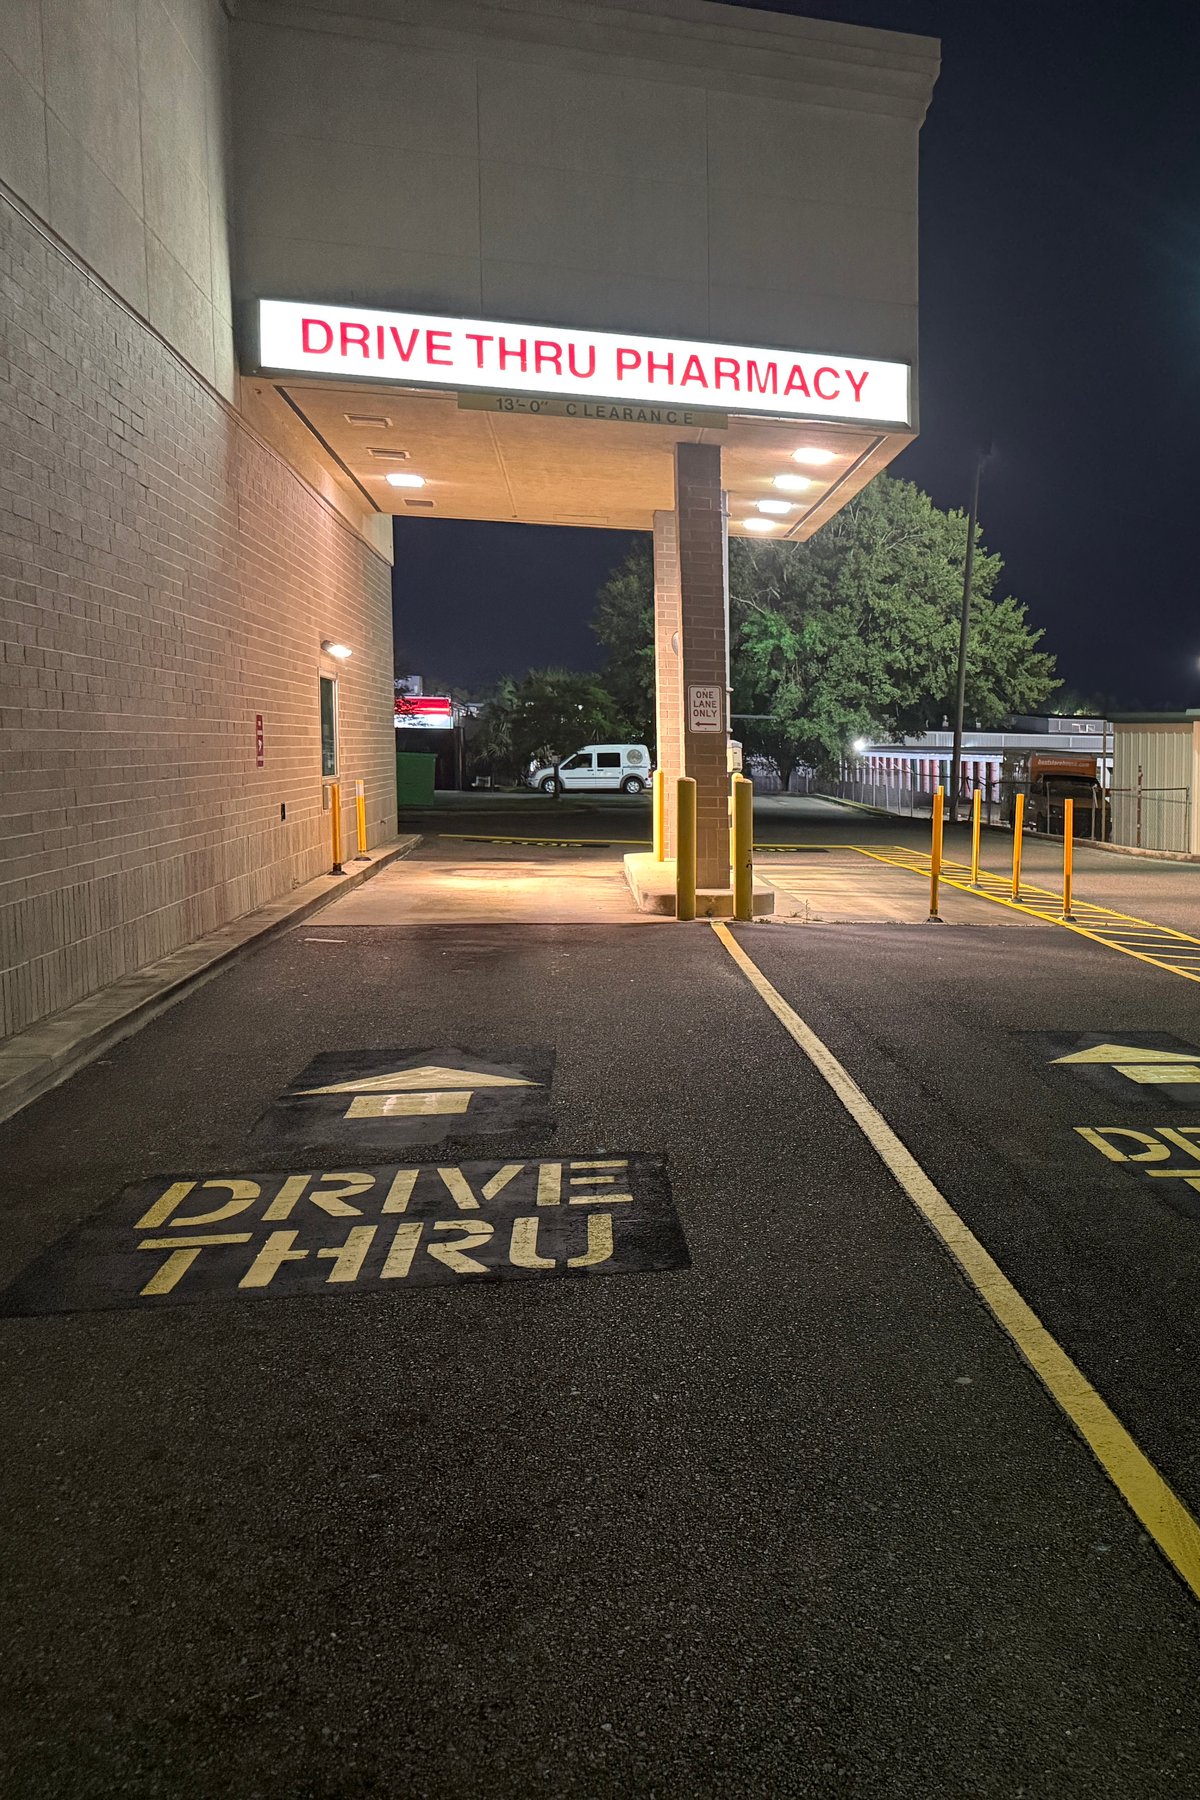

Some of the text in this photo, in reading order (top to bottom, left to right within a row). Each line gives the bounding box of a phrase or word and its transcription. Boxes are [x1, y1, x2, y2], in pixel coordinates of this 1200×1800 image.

[301, 318, 870, 403] DRIVE THRU PHARMACY
[496, 398, 694, 425] 13'-0" CLEARANCE
[693, 700, 717, 709] LANE
[695, 690, 714, 699] ONE
[693, 709, 717, 718] ONLY
[132, 1159, 635, 1230] DRIVE
[136, 1213, 614, 1297] THRU
